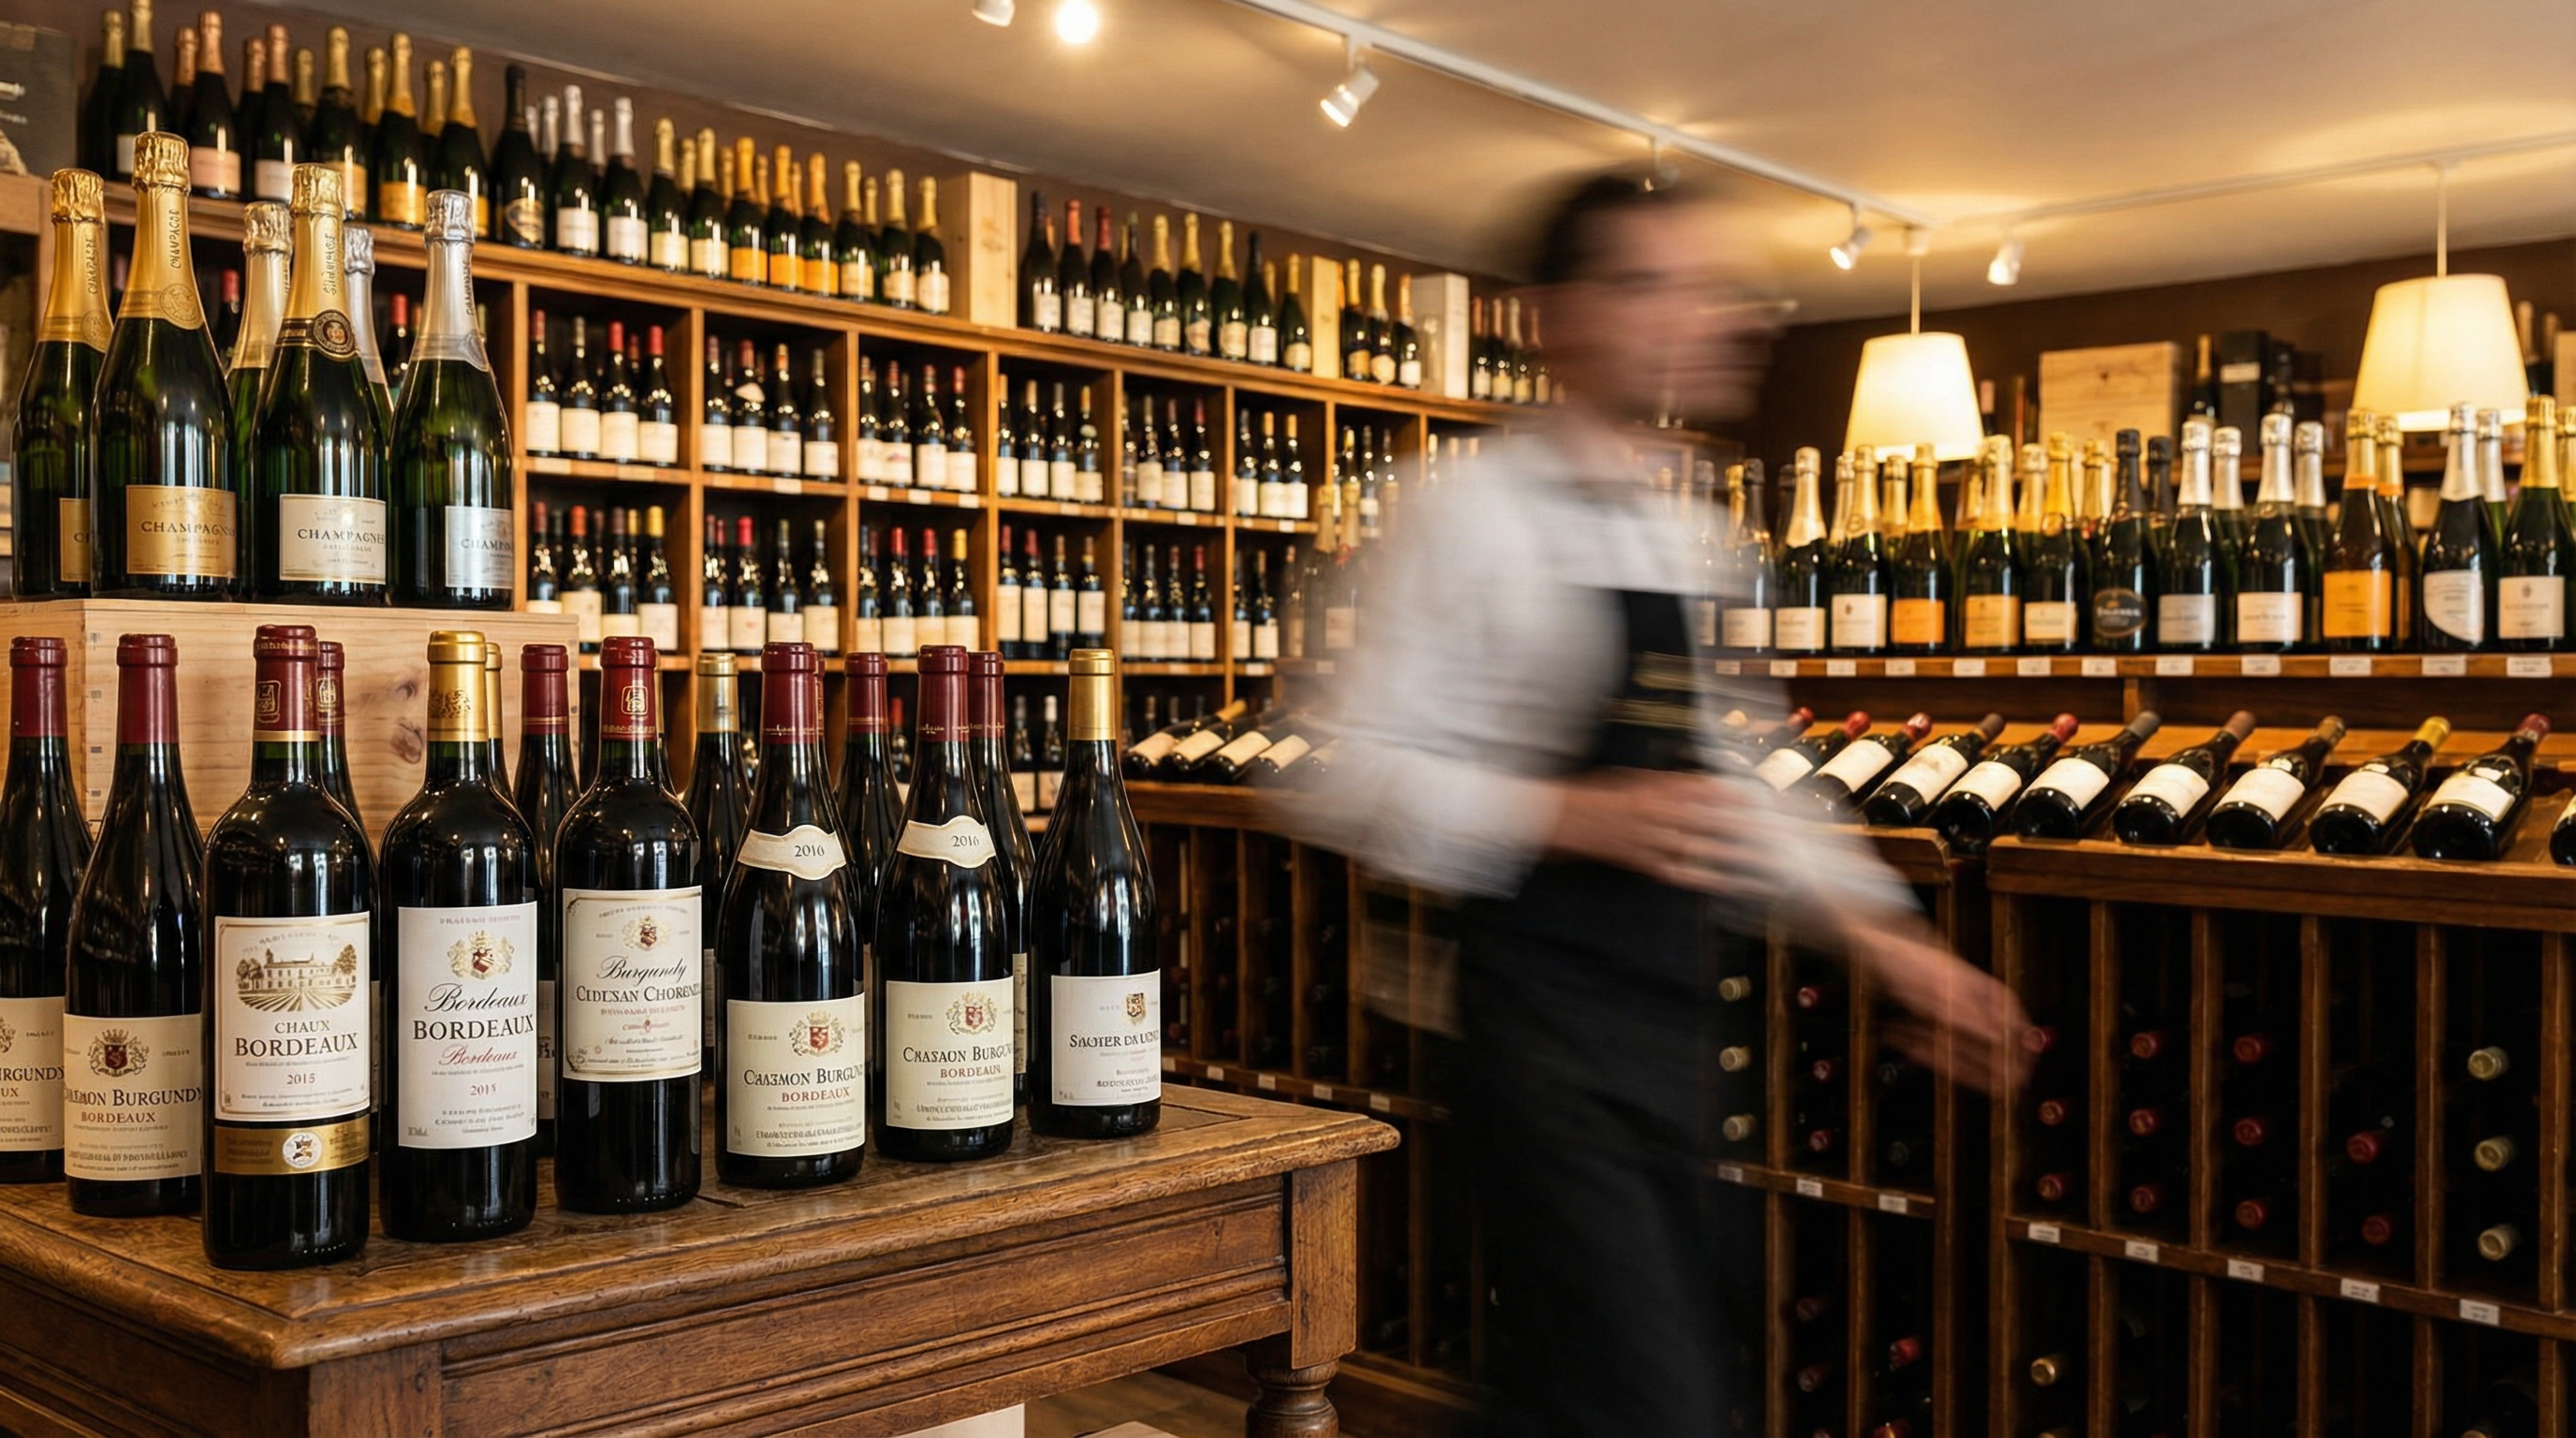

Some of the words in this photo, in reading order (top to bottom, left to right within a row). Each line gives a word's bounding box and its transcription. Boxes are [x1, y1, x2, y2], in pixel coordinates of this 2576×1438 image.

[951, 835, 980, 847] 2016
[794, 844, 826, 858] 2016
[596, 955, 688, 987] Burgundy
[424, 983, 529, 1013] Bordeaux
[274, 1020, 330, 1034] CHAUX
[413, 1014, 534, 1040] BORDEAUX
[235, 1032, 358, 1058] BORDEAUX
[438, 1044, 519, 1066] Bordeaux
[286, 1073, 316, 1085] 2015
[782, 1086, 850, 1103] BORDEAUX
[80, 1111, 156, 1123] BORDEAUX
